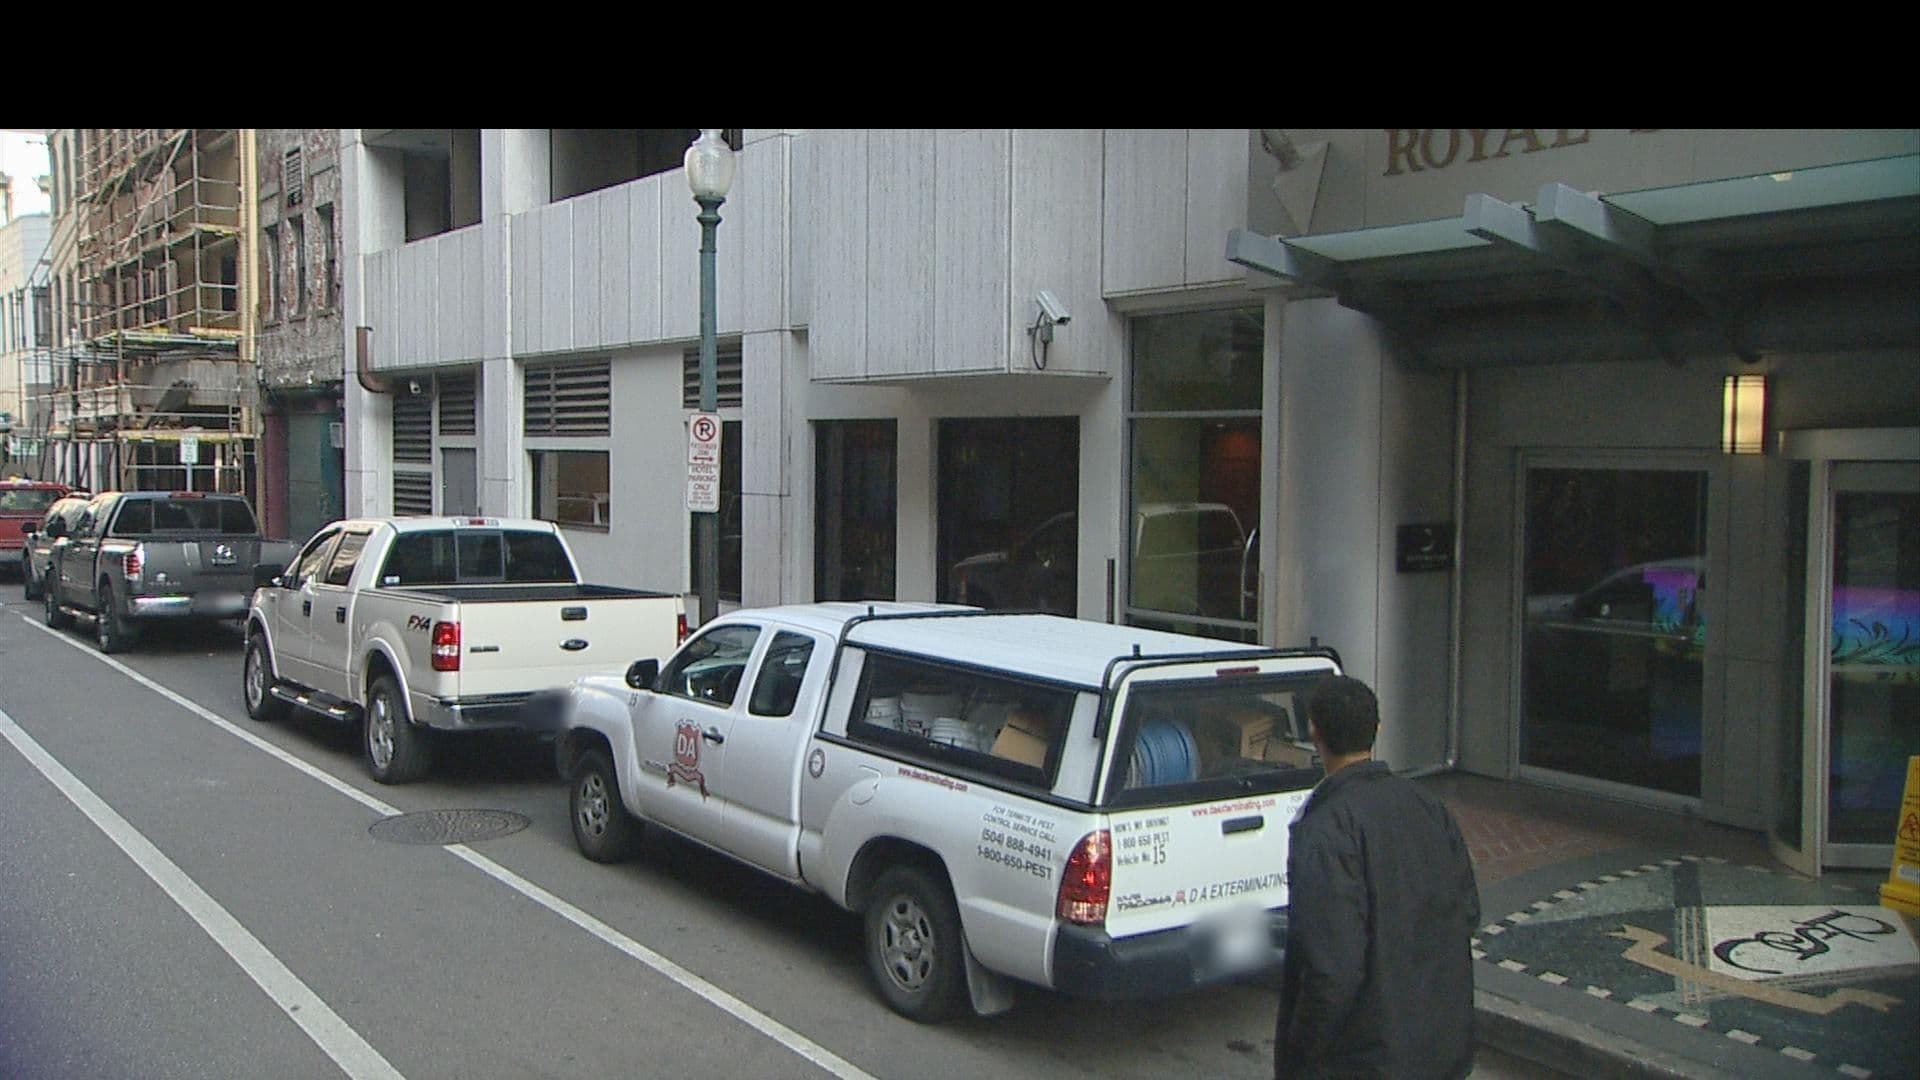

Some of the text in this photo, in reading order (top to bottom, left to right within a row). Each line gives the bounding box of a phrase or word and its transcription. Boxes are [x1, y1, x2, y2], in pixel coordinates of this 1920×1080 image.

[693, 483, 711, 491] ONLY
[407, 614, 432, 631] FX4
[677, 732, 697, 760] DA
[983, 812, 1012, 830] CONTROL
[1012, 822, 1039, 837] SERVICE
[992, 804, 1006, 815] FOR
[1006, 809, 1032, 824] TERMITE
[1038, 819, 1056, 830] PEST
[982, 828, 1052, 862] (504) 888-4941
[1153, 831, 1170, 844] PEST
[977, 844, 1054, 881] 1-800-650-PEST
[1117, 852, 1140, 867] Vehicle
[1153, 844, 1167, 865] 15
[1189, 887, 1199, 903] D
[1200, 885, 1208, 900] A
